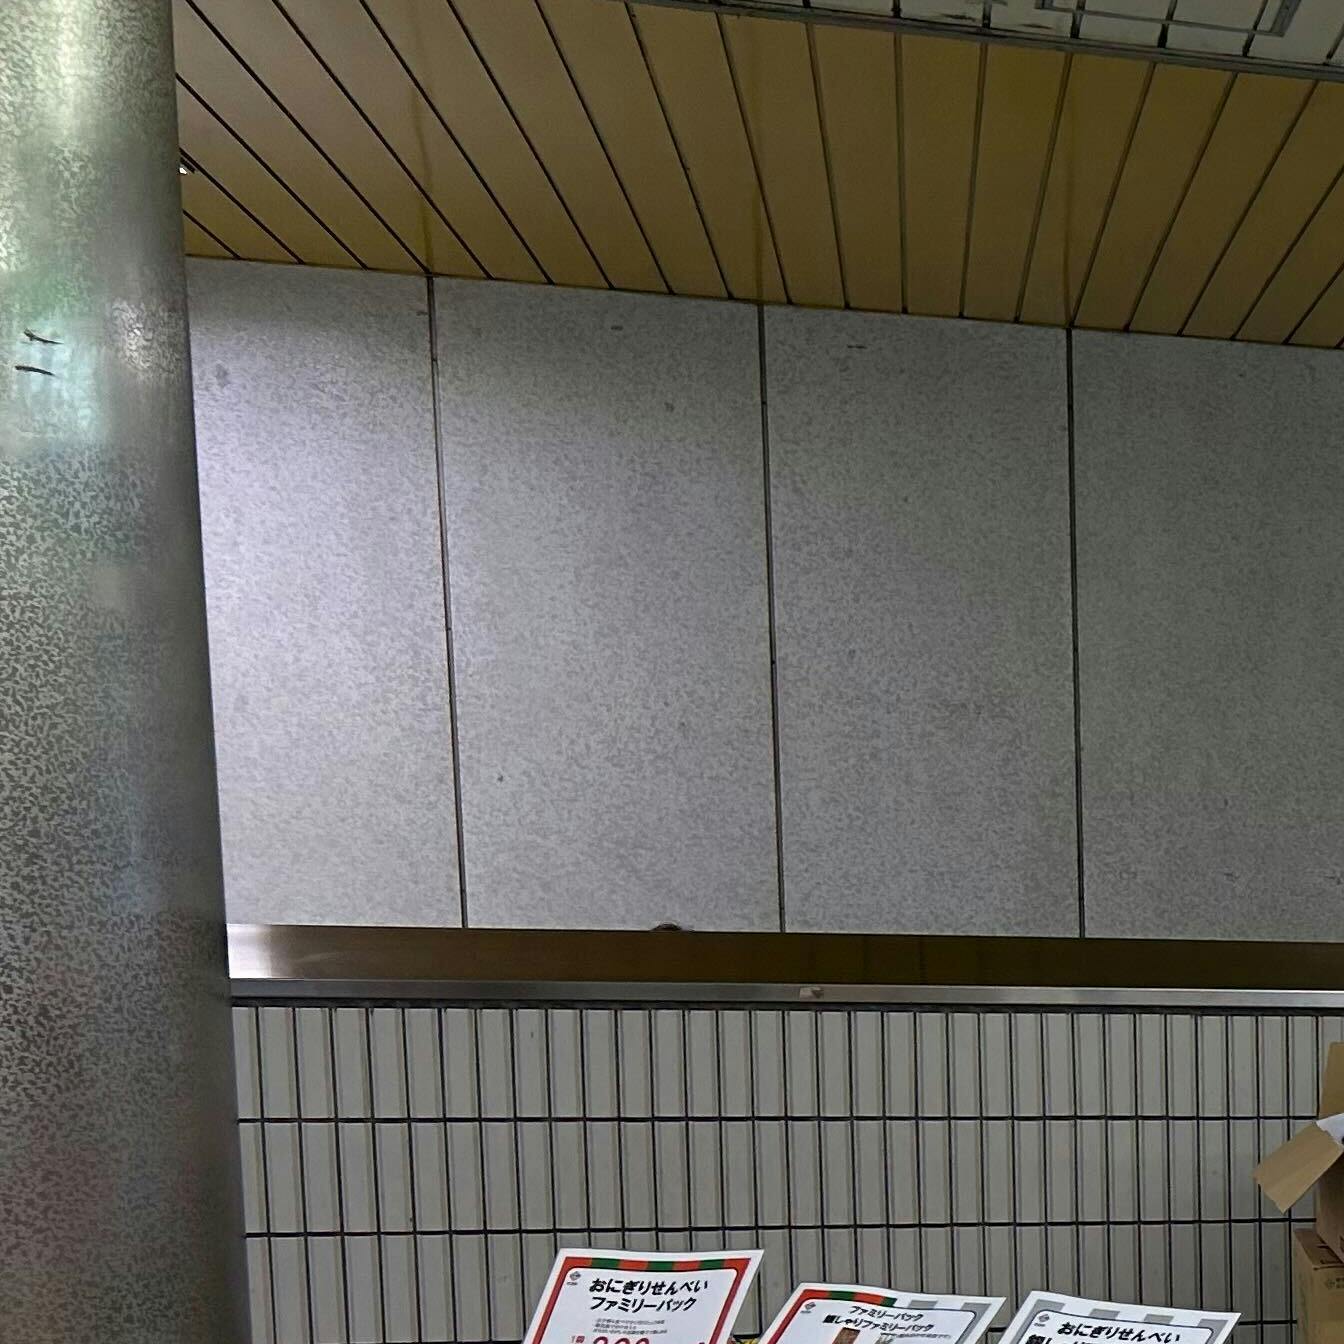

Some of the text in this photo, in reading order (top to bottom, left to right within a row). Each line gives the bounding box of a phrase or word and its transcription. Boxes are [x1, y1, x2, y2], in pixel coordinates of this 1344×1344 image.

[589, 1279, 708, 1296] おにぎりせんべい
[590, 1297, 697, 1314] ファミリーパック
[848, 1305, 924, 1322] ファミリーパック
[822, 1314, 935, 1332] 銀しゃりファミリーパック
[1057, 1321, 1181, 1344] おにぎりせんべい
